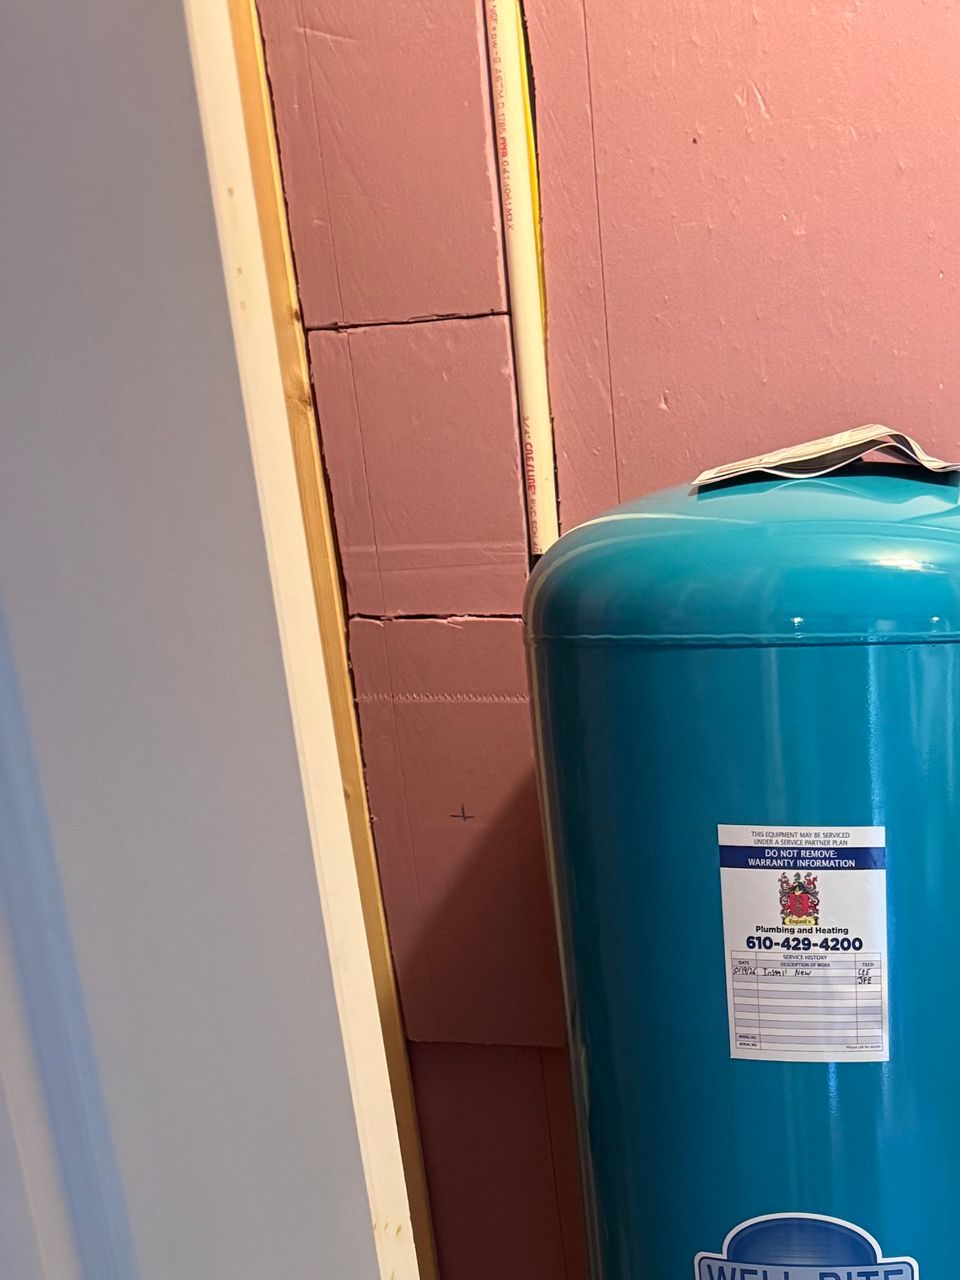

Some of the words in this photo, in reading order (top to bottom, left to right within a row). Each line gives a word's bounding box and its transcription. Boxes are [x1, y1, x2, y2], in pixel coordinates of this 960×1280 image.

[765, 849, 778, 857] DO
[780, 850, 797, 858] NOT
[800, 850, 838, 858] REMOVE:
[748, 858, 794, 867] WARRANTY
[796, 859, 856, 867] INFORMATION
[755, 925, 795, 935] Plumbing
[797, 926, 813, 934] and
[815, 927, 849, 935] Heating
[746, 936, 863, 951] 610-429-4200
[795, 968, 812, 976] New
